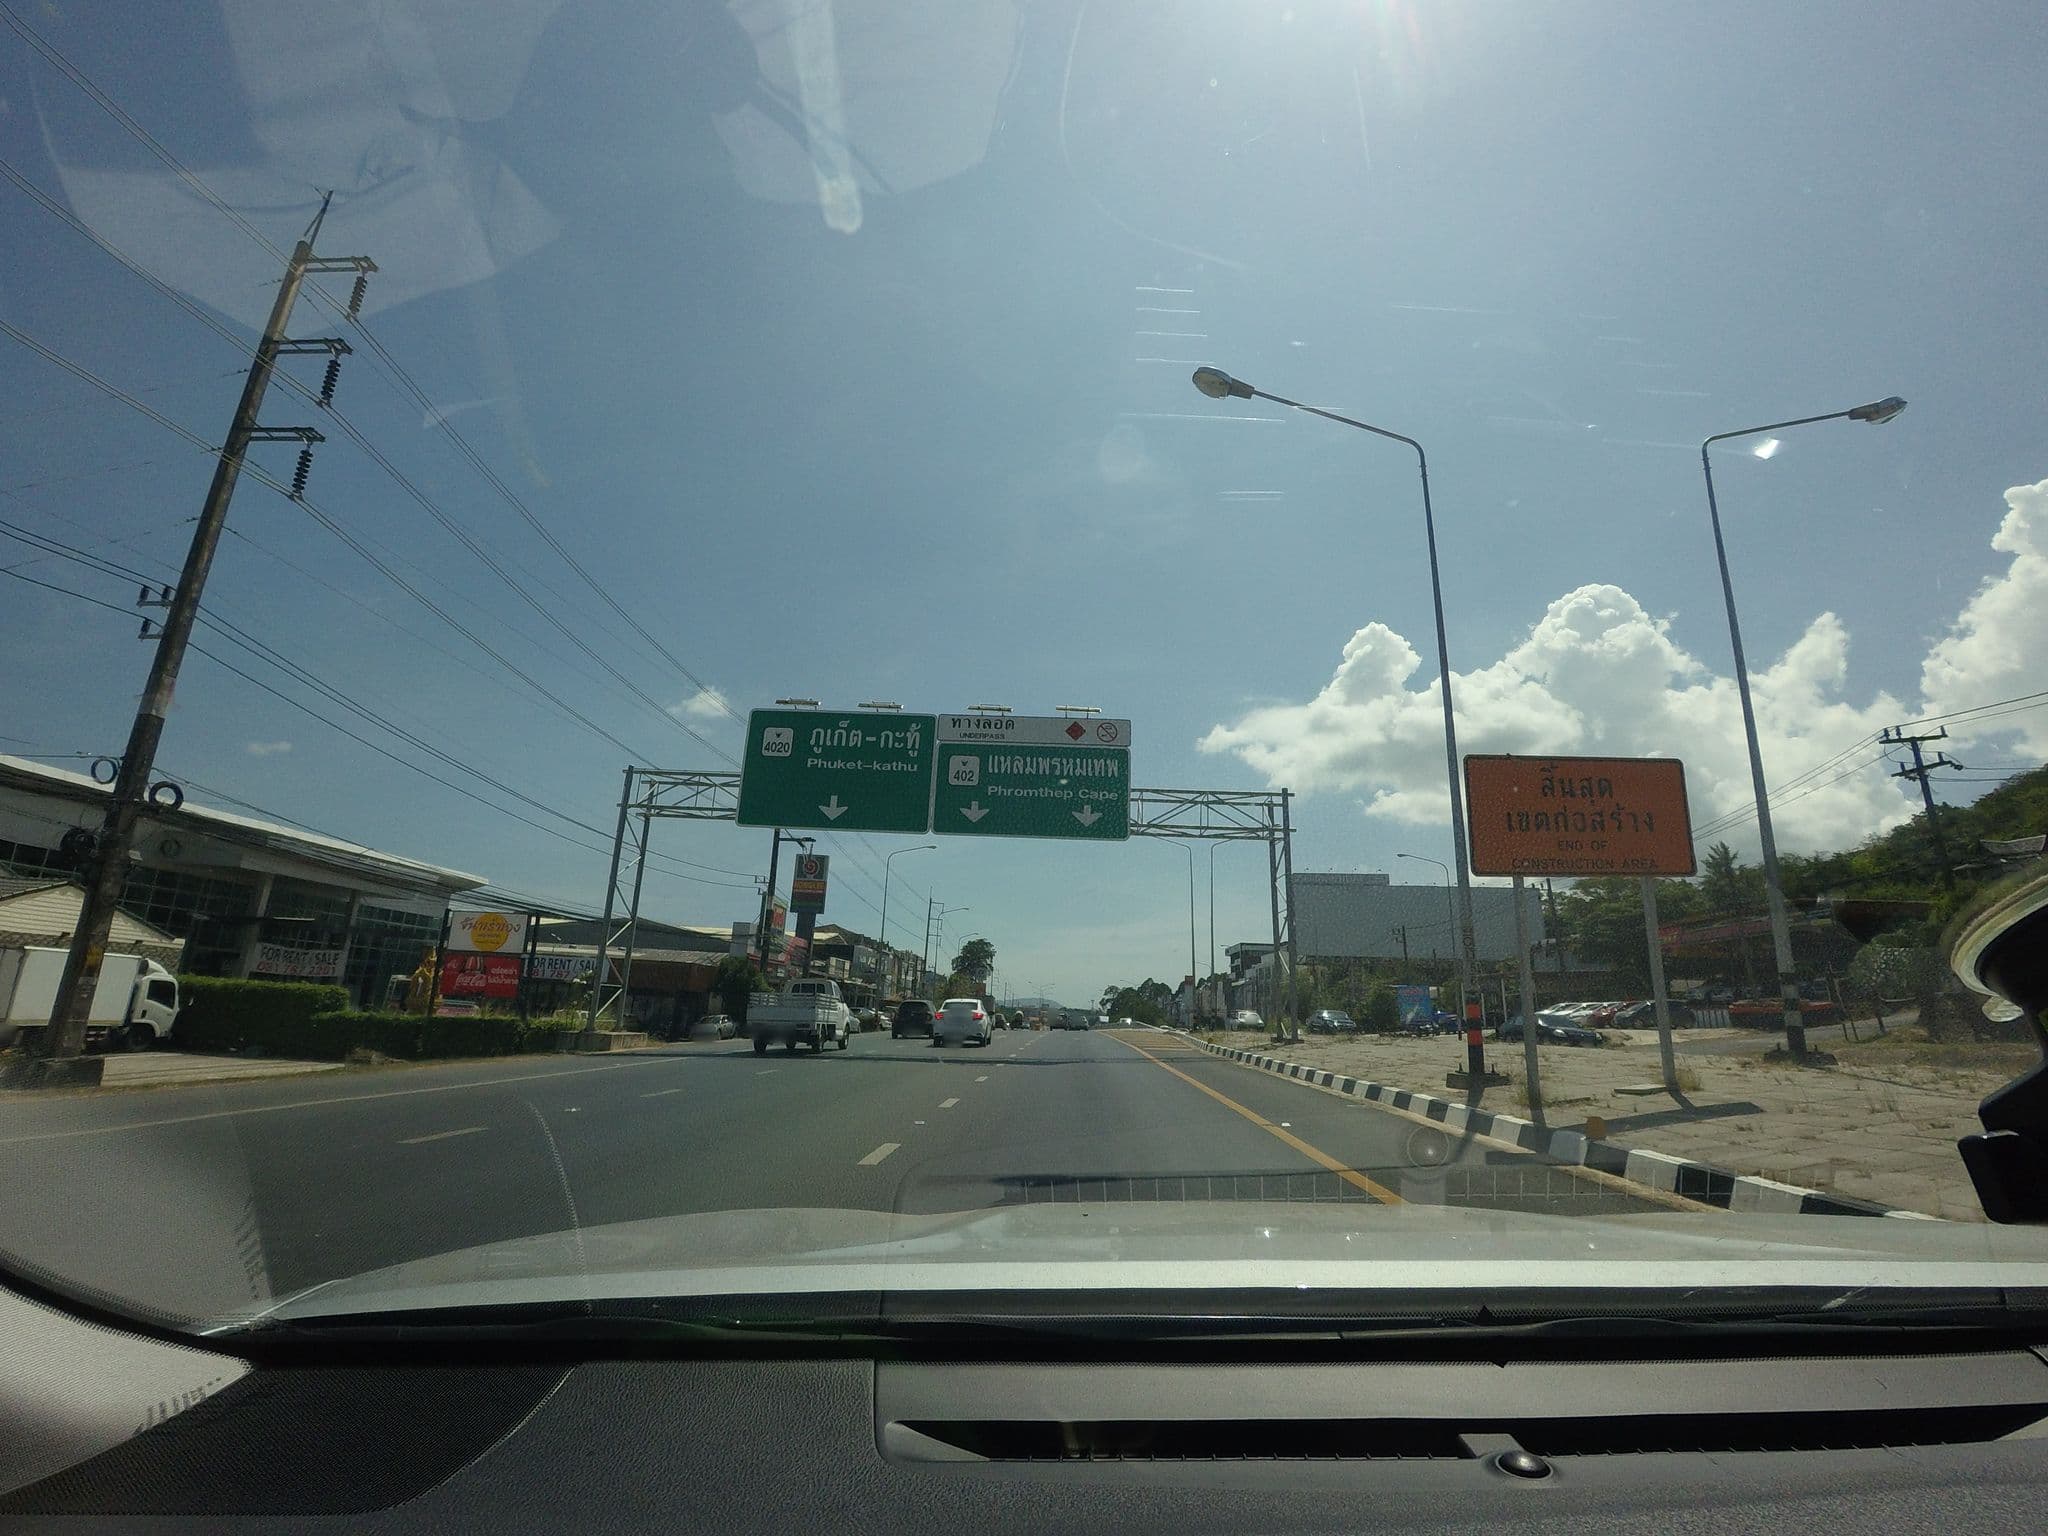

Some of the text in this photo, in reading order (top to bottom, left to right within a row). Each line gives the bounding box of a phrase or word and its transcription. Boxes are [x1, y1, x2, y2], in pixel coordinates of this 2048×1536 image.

[951, 717, 1015, 730] ทางลอด
[959, 732, 1005, 740] UNDERPASS
[764, 741, 790, 754] 4020
[987, 755, 1119, 777] แหลมพรหมเทพ
[953, 770, 975, 782] 402
[1540, 765, 1614, 806] สิ้นสุด
[987, 785, 1119, 801] Phromthep Cape
[1506, 803, 1656, 833] เขตก่อสร้าง
[1558, 840, 1609, 850] END OF
[1511, 858, 1659, 870] CONSTRUCTION AREA
[261, 946, 281, 961] FOR
[282, 949, 309, 962] RENT
[314, 952, 340, 963] SALE
[547, 957, 573, 970] RENT
